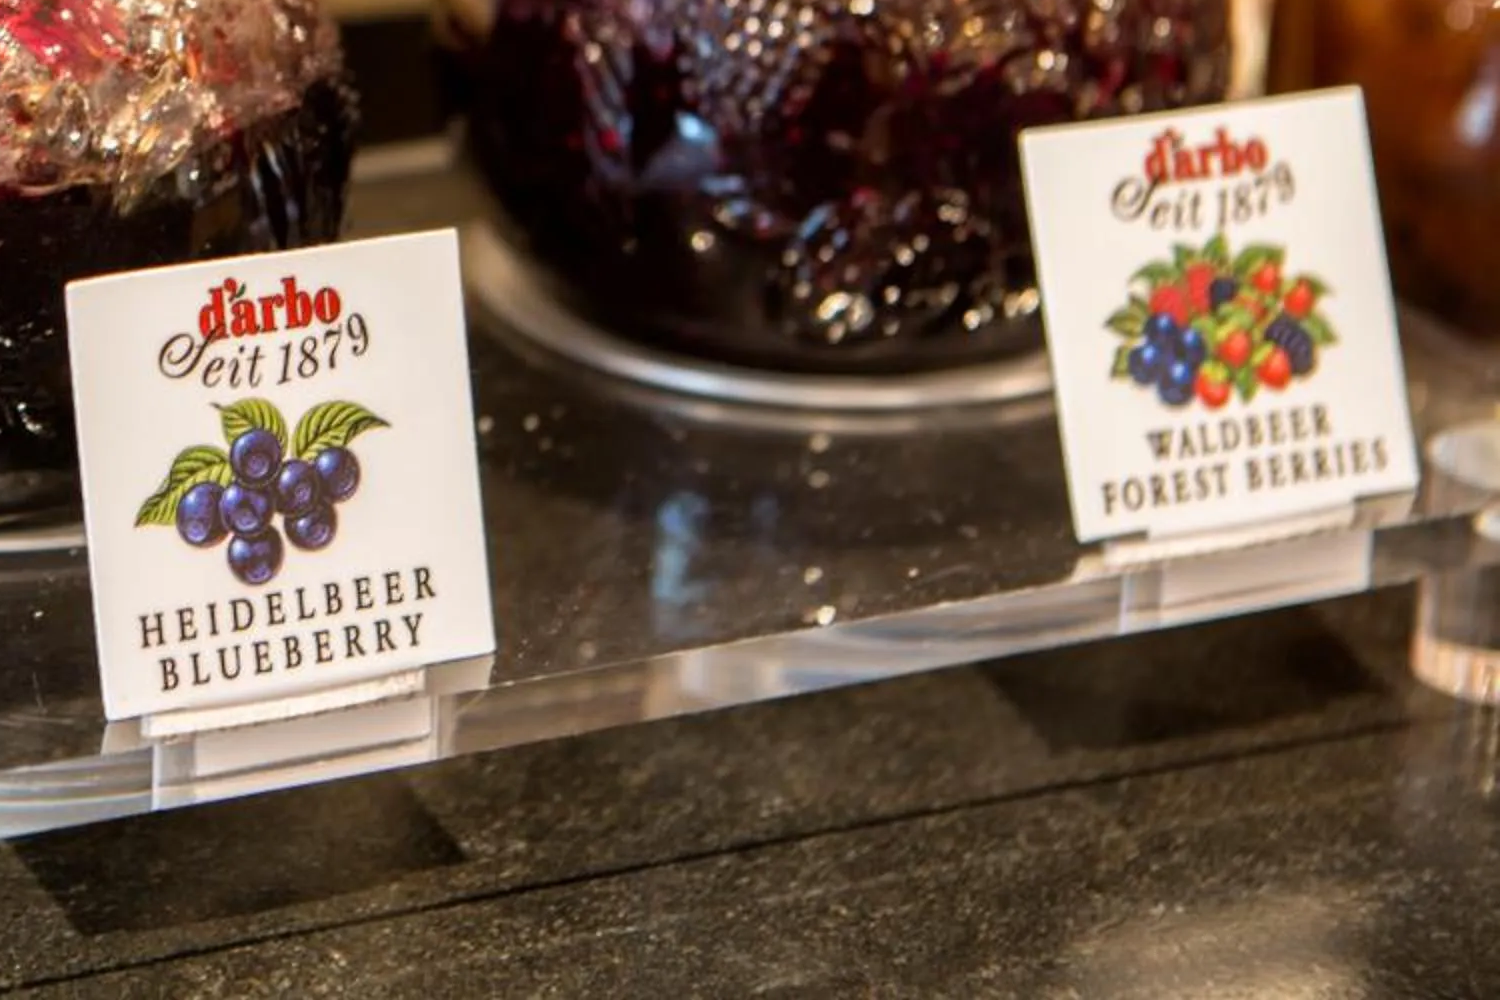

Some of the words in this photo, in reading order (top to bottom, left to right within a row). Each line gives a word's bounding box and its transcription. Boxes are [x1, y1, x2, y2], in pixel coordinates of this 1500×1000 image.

[1110, 176, 1202, 231] Seit
[1215, 162, 1296, 229] 1879
[157, 327, 266, 389] Seit
[275, 312, 370, 386] 1879
[1146, 405, 1332, 462] WALDBEER
[1100, 464, 1230, 518] FOREST
[1245, 436, 1388, 494] BERRIES
[139, 566, 437, 649] HEIDELBEER
[159, 612, 426, 693] BLUEBERRY
